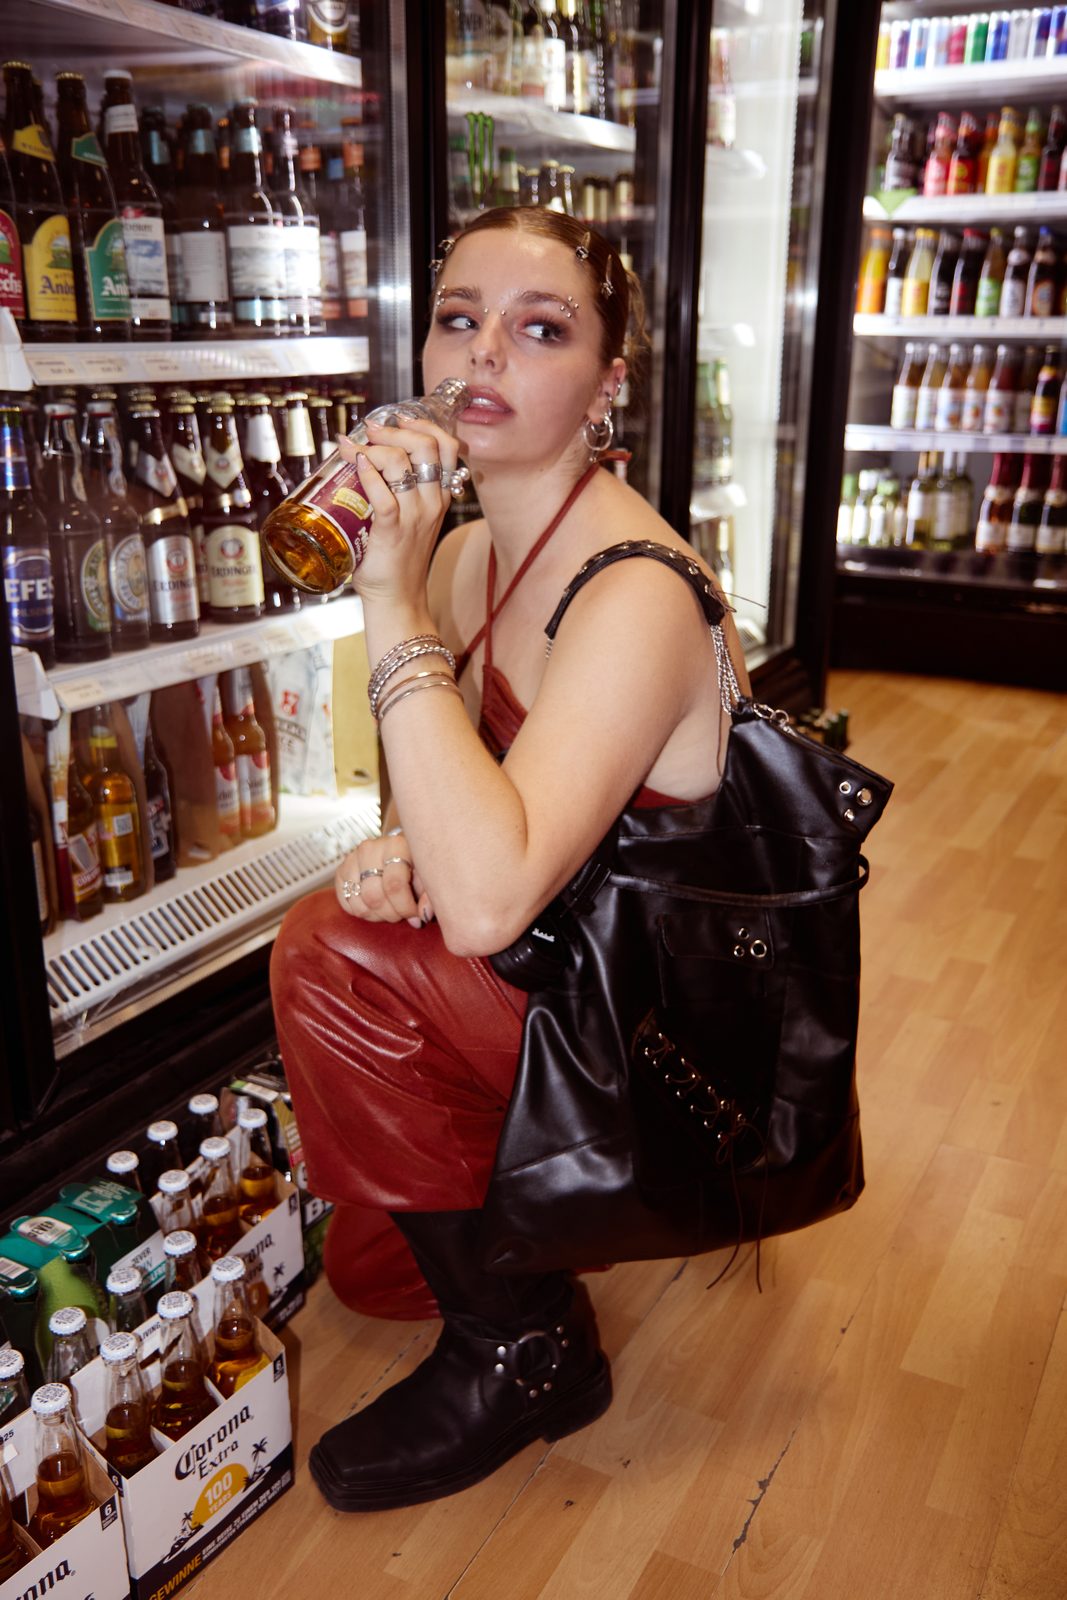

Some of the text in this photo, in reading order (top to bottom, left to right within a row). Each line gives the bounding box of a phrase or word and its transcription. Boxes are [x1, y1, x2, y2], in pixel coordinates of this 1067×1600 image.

[175, 1404, 251, 1480] Corona
[198, 1438, 239, 1480] Extra
[112, 1475, 119, 1487] 6
[204, 1471, 233, 1506] 100
[104, 1503, 113, 1516] 6
[208, 1491, 233, 1514] YEARS
